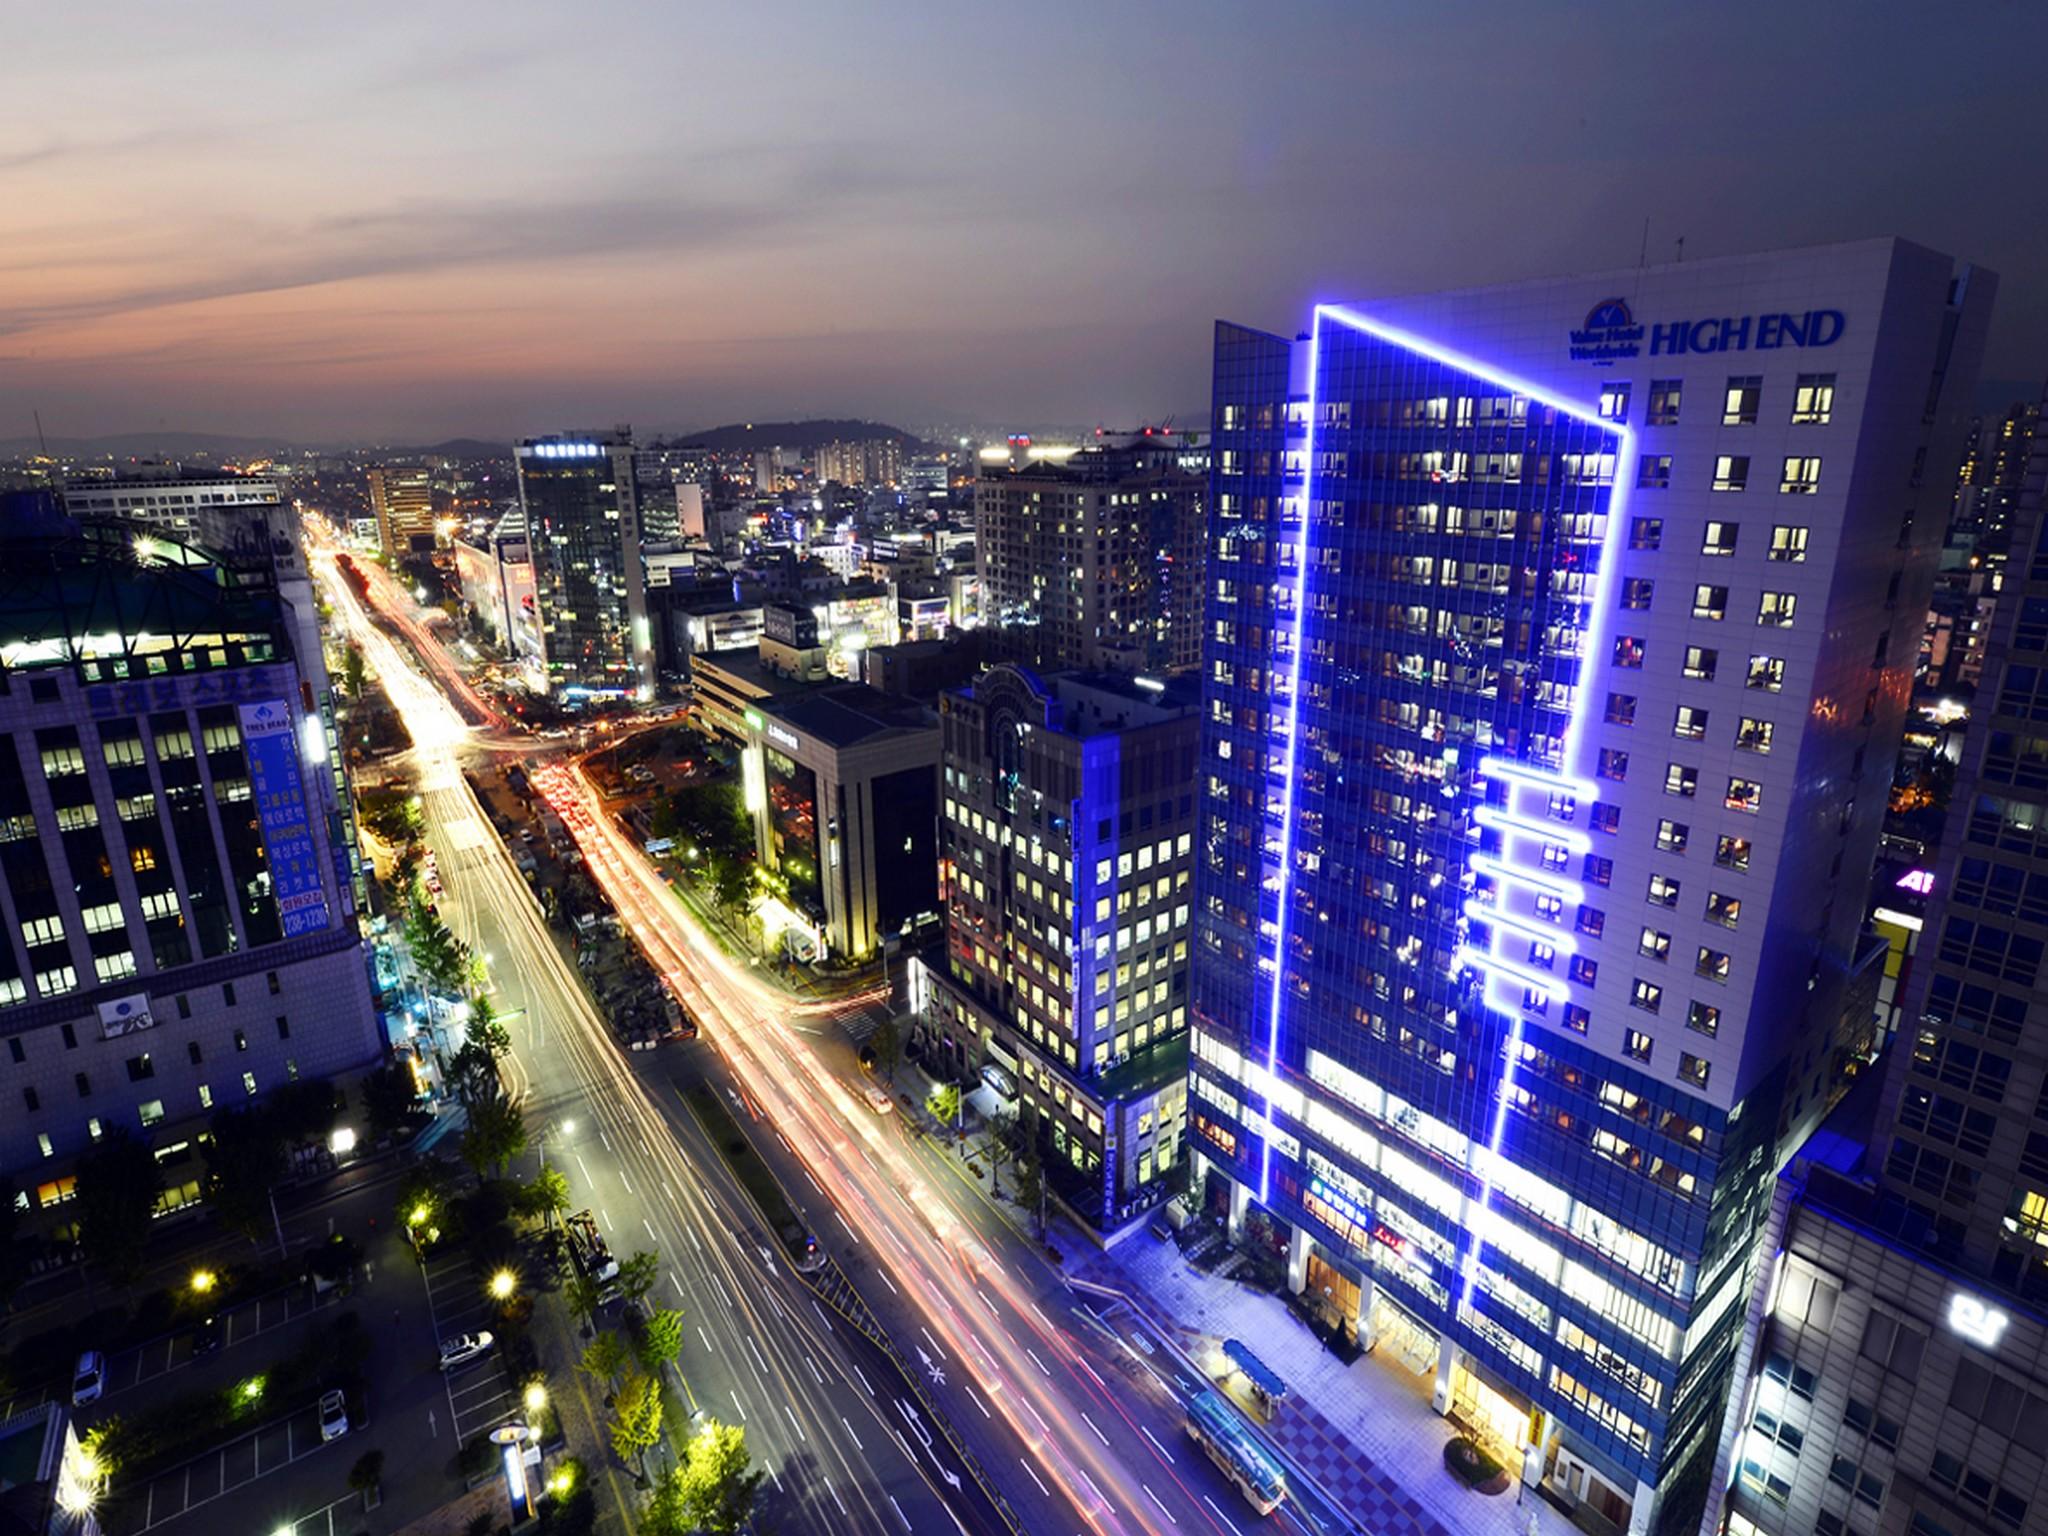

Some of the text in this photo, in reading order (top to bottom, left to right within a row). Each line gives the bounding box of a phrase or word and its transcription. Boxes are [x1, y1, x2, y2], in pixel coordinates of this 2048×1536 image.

[1570, 325, 1645, 344] Value Hotel
[1650, 310, 1845, 356] HIGH END
[1569, 343, 1640, 360] Worldwide
